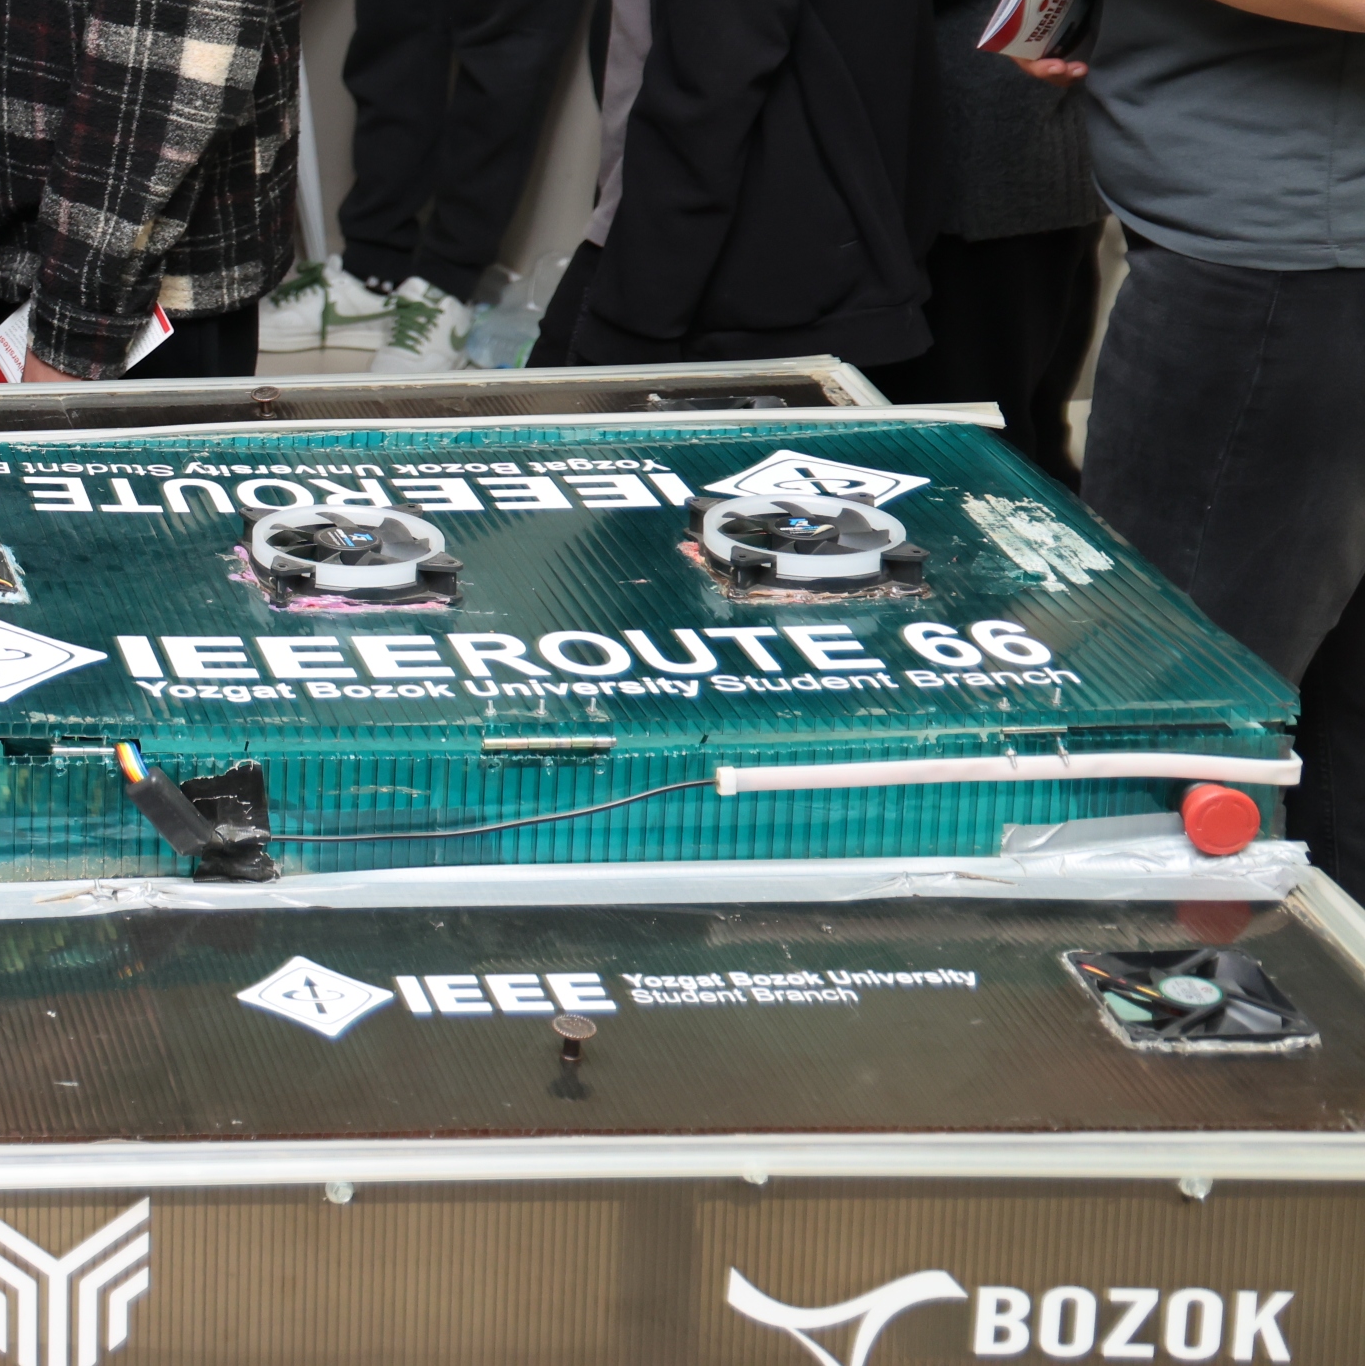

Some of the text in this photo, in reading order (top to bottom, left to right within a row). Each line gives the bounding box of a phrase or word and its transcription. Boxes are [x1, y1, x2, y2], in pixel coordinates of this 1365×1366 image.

[22, 461, 174, 478] Student
[186, 461, 387, 478] University
[391, 461, 519, 477] Bozok
[528, 456, 673, 475] Yozgat
[902, 619, 1053, 668] 66
[135, 665, 1082, 703] Yozgat Bozok University Student Branch
[392, 968, 977, 1014] IEEE Yozgat Bozok University
[629, 985, 860, 1005] Student Branch
[972, 1285, 1295, 1362] BOZOK
